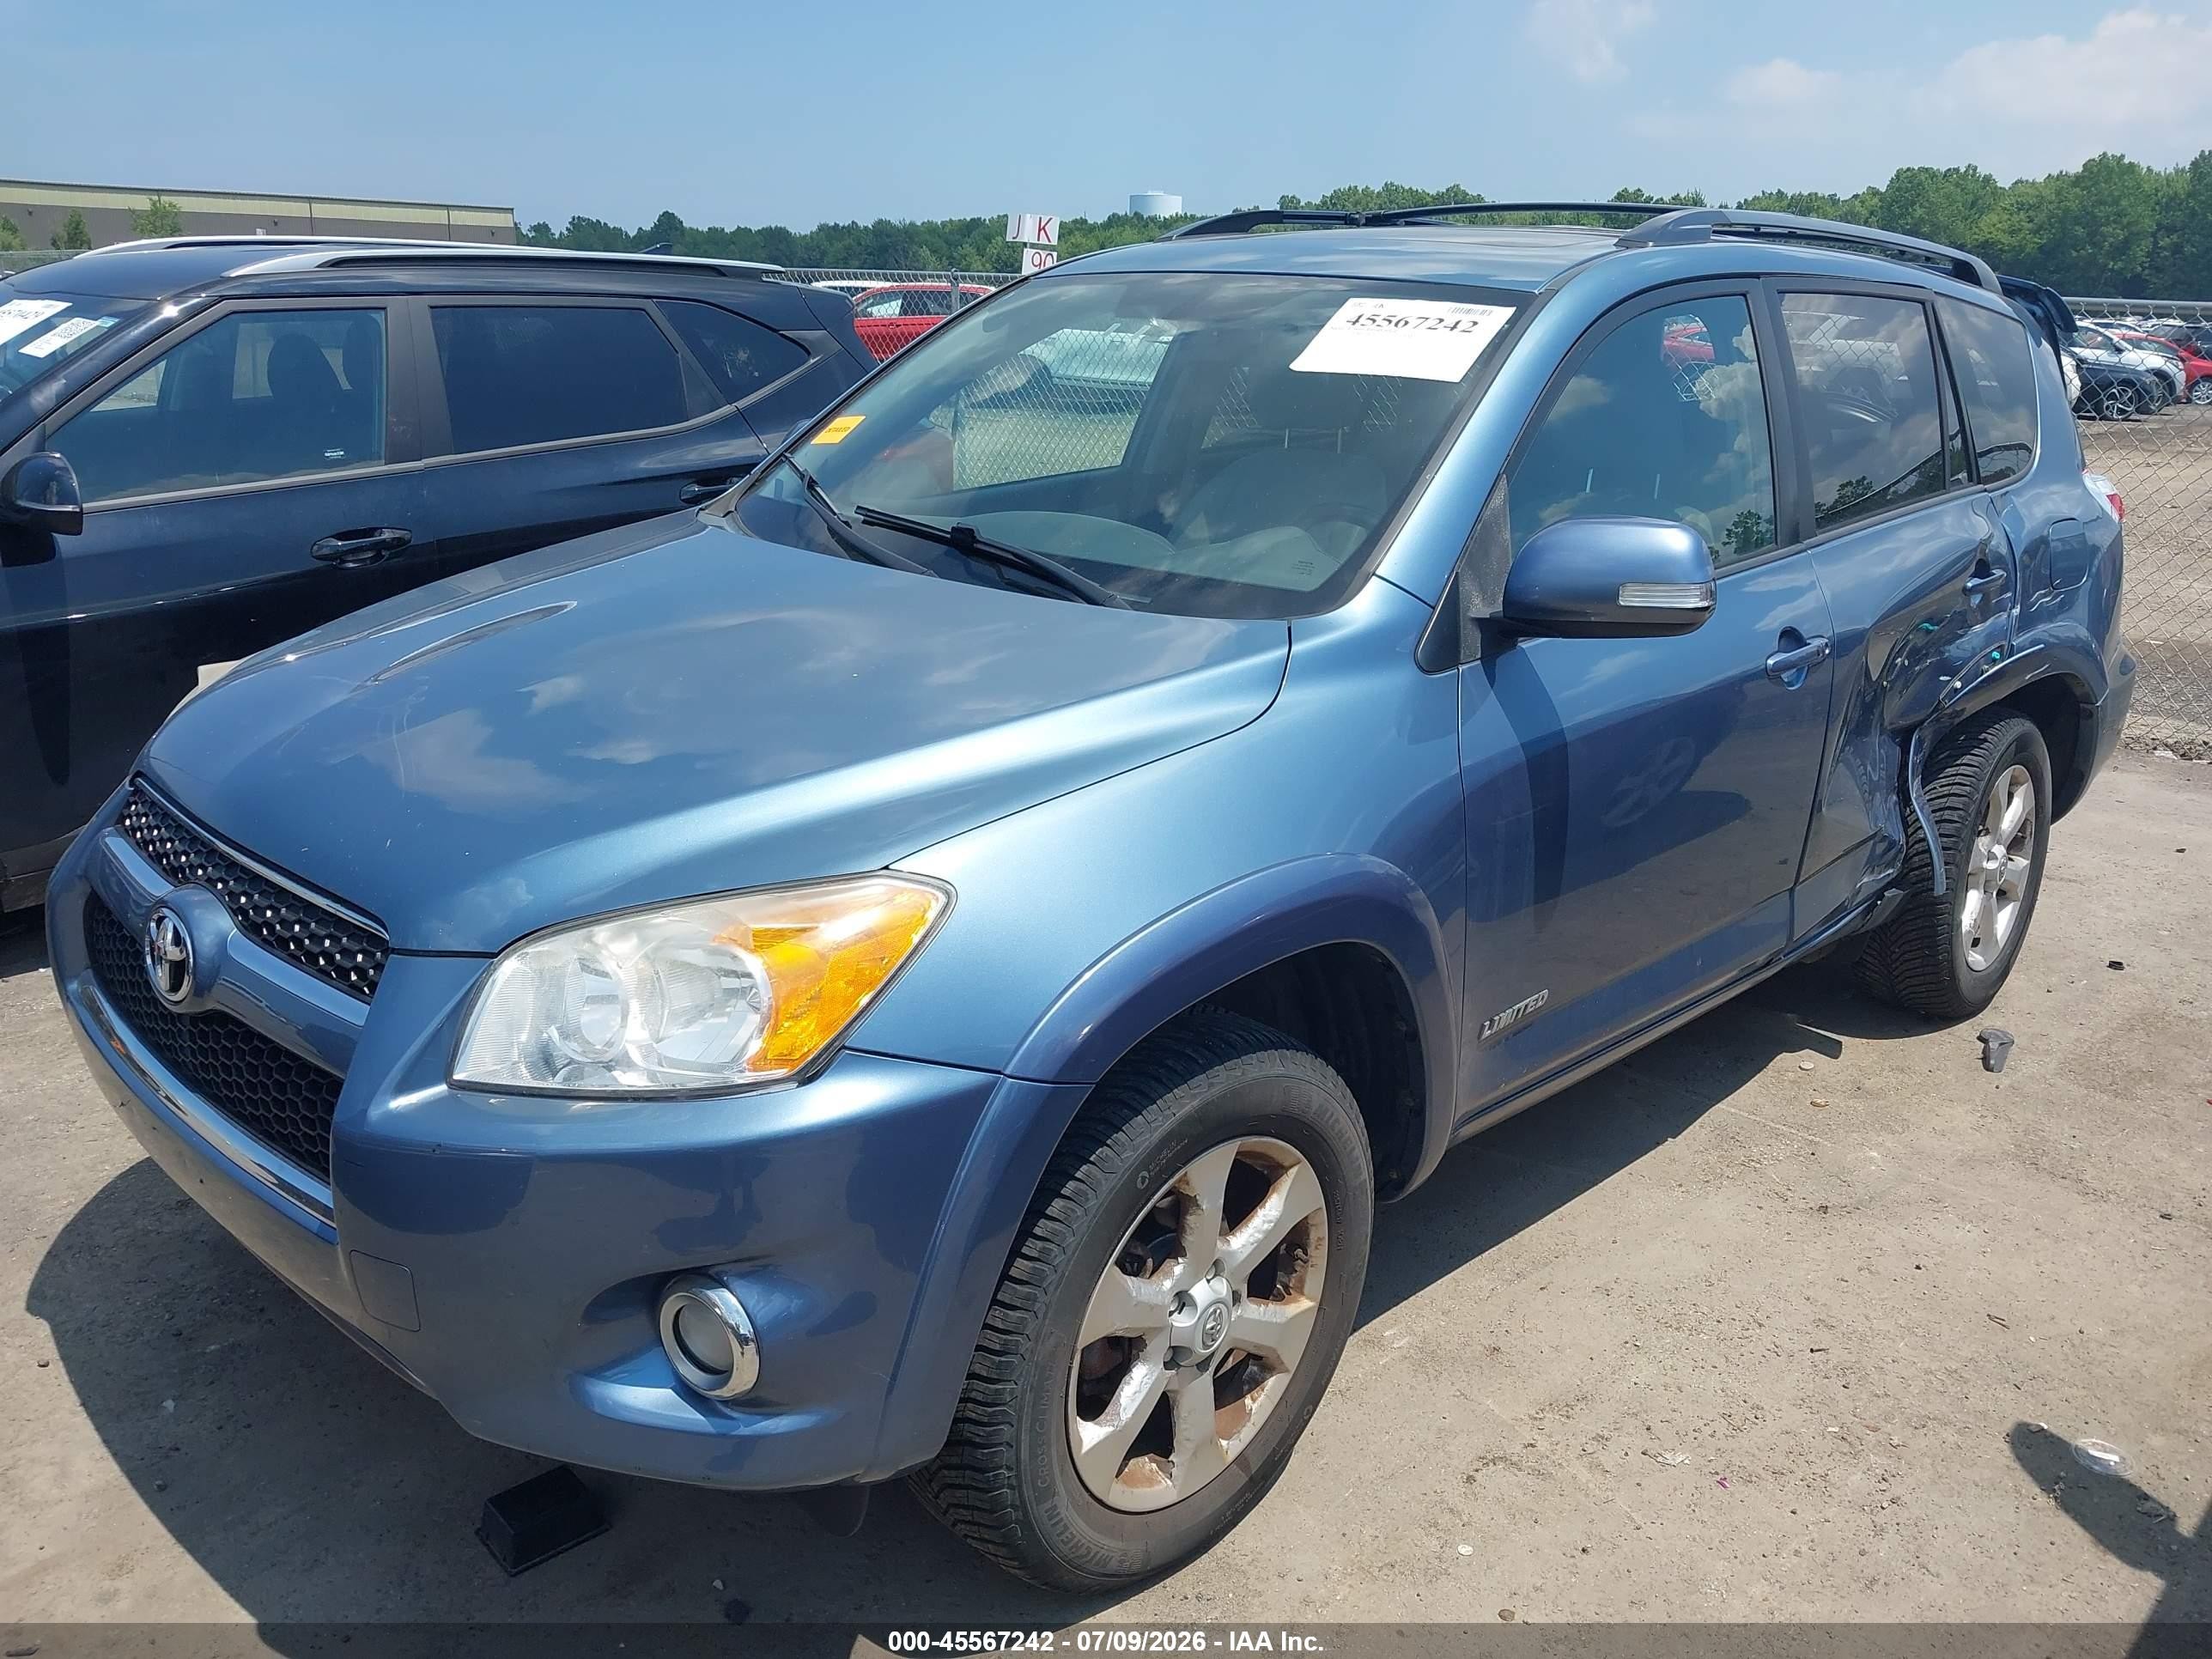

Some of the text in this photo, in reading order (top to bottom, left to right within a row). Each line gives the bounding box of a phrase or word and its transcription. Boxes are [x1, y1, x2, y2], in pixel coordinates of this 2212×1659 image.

[1012, 214, 1053, 244] J K
[1346, 313, 1480, 334] 45567242
[1479, 988, 1549, 1041] LIMITED
[1042, 1503, 1115, 1569] MICHELIN
